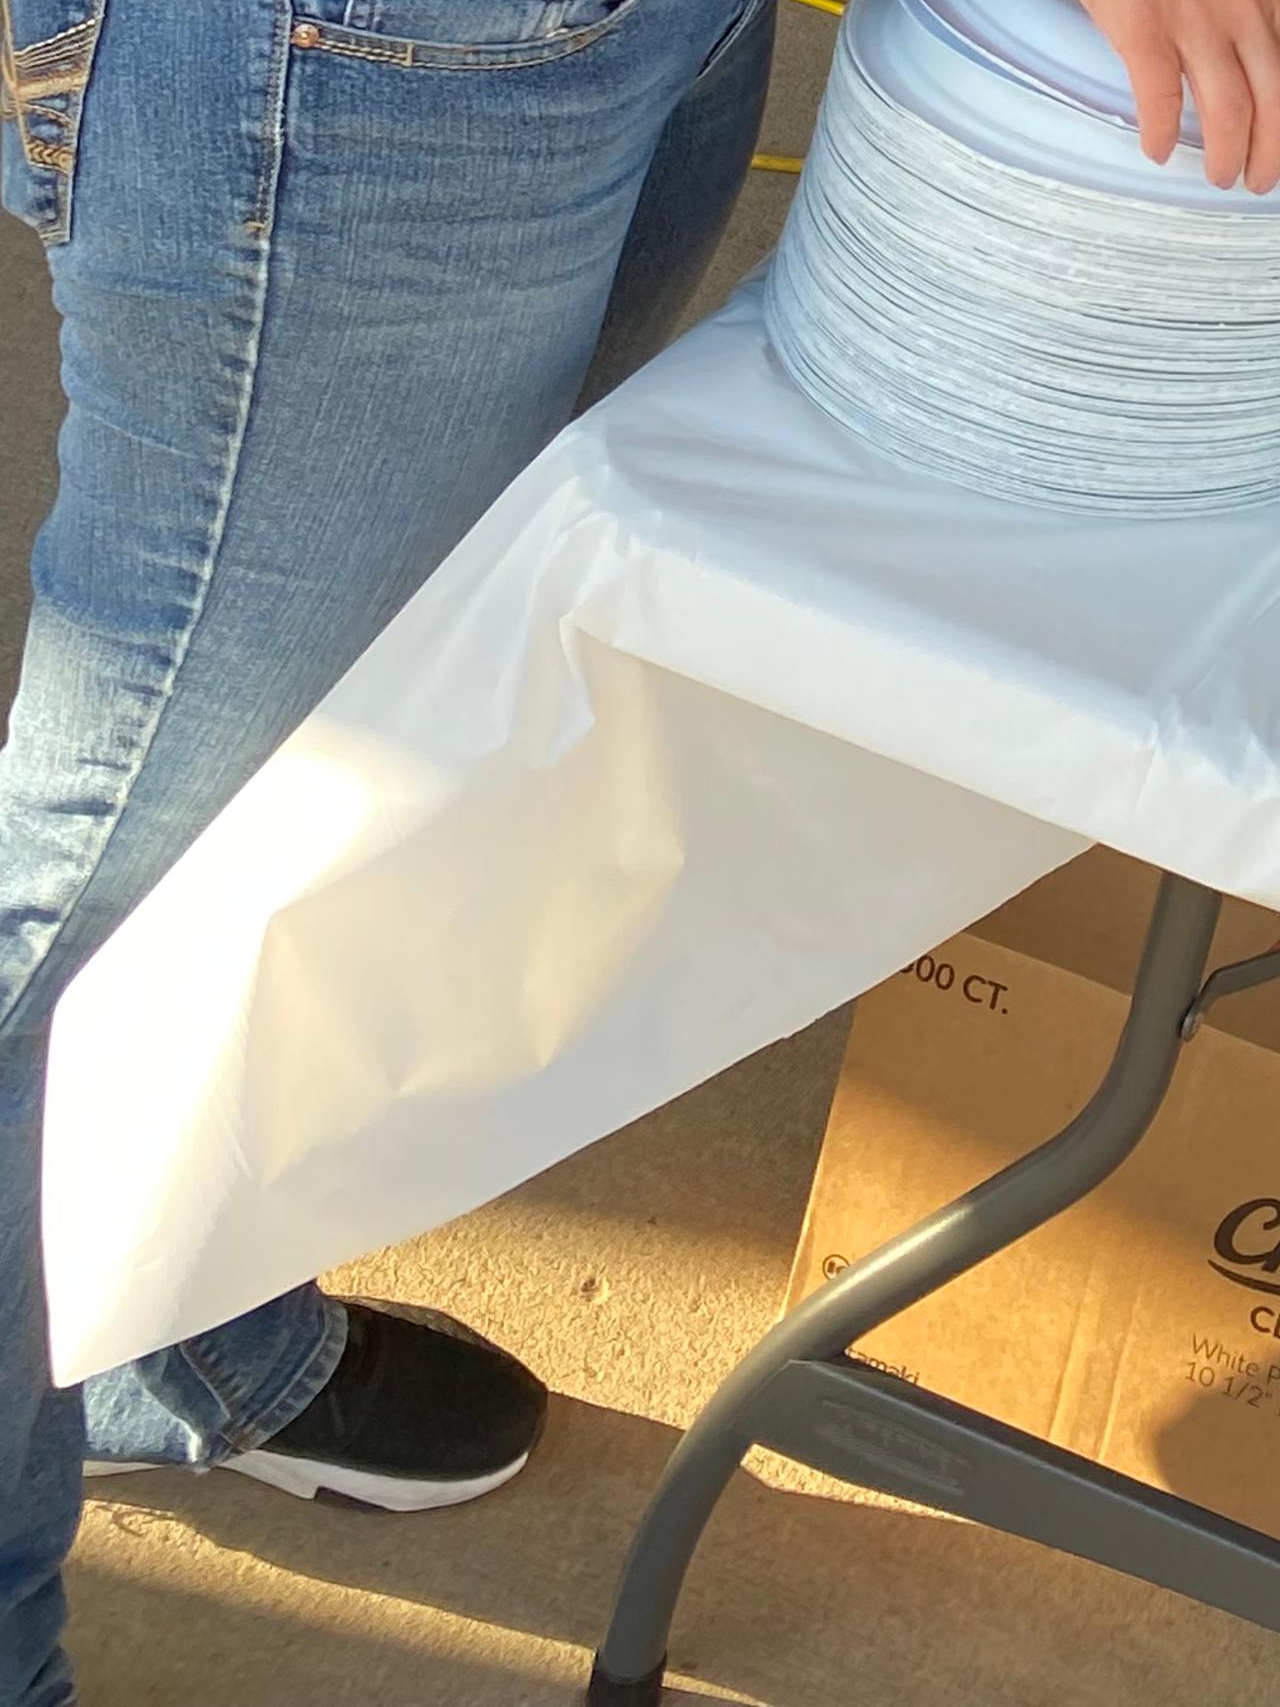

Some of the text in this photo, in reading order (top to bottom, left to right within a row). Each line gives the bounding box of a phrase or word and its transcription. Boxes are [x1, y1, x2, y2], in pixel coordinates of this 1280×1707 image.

[963, 975, 1008, 1015] CT.
[1191, 1334, 1260, 1377] White
[1185, 1361, 1216, 1387] 10
[1222, 1377, 1273, 1409] 1/2"
